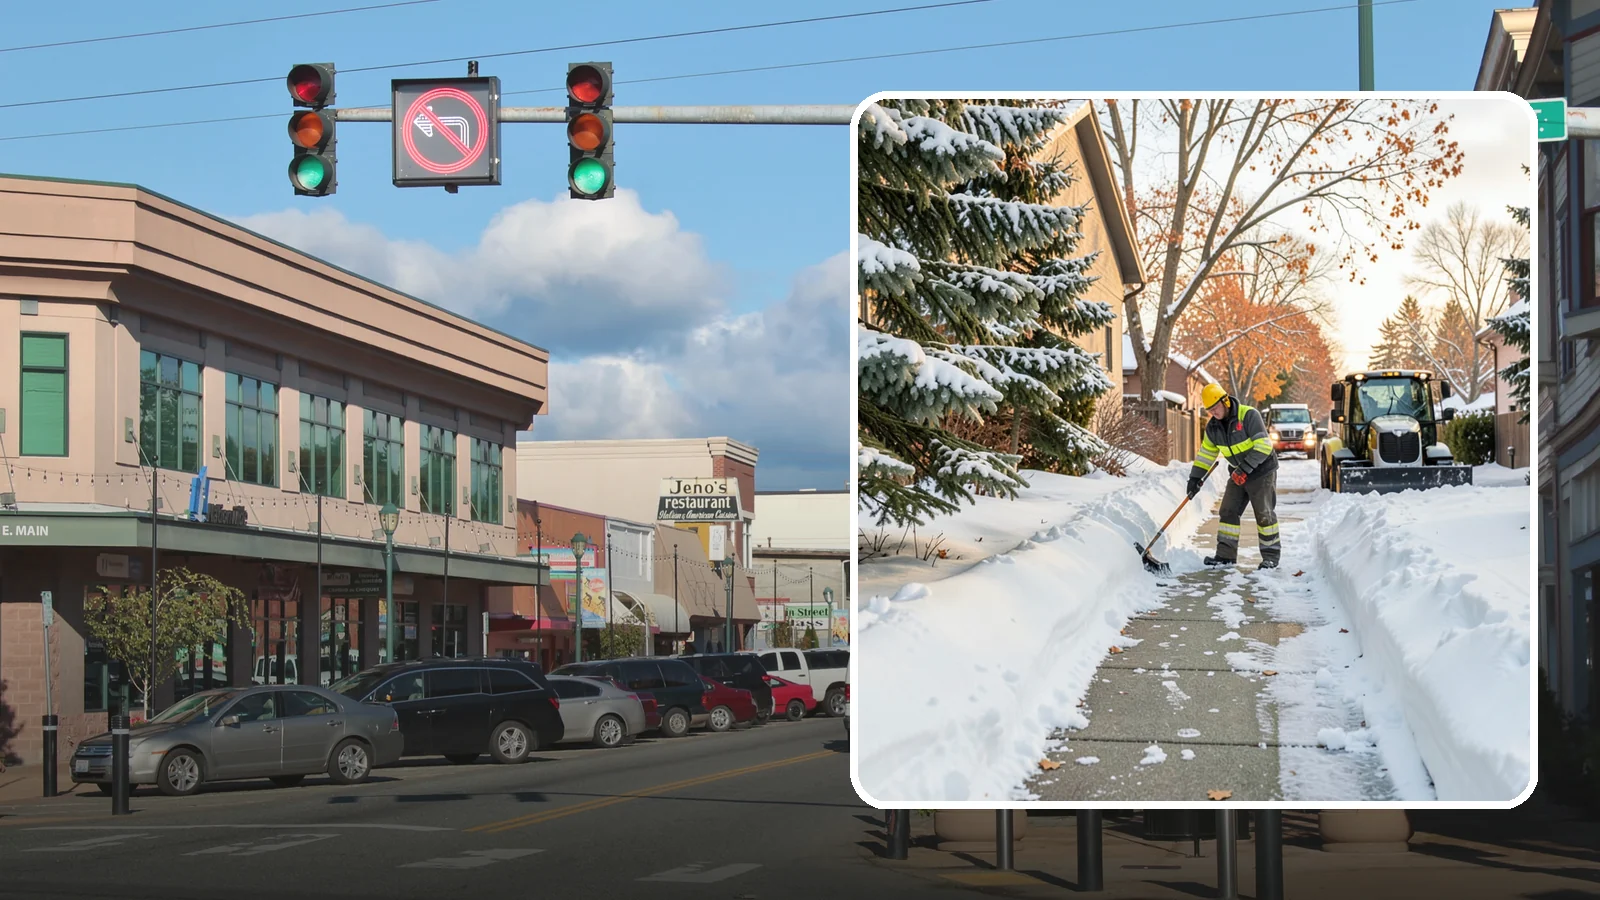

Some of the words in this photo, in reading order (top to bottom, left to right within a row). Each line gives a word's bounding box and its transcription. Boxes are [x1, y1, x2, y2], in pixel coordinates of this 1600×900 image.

[670, 480, 727, 494] Jeno's
[665, 496, 731, 509] restaurant
[659, 510, 681, 519] Italian
[686, 510, 714, 519] American
[715, 510, 737, 519] Cuisine
[2, 525, 13, 536] E.
[15, 525, 49, 536] MAIN
[797, 608, 828, 617] Street
